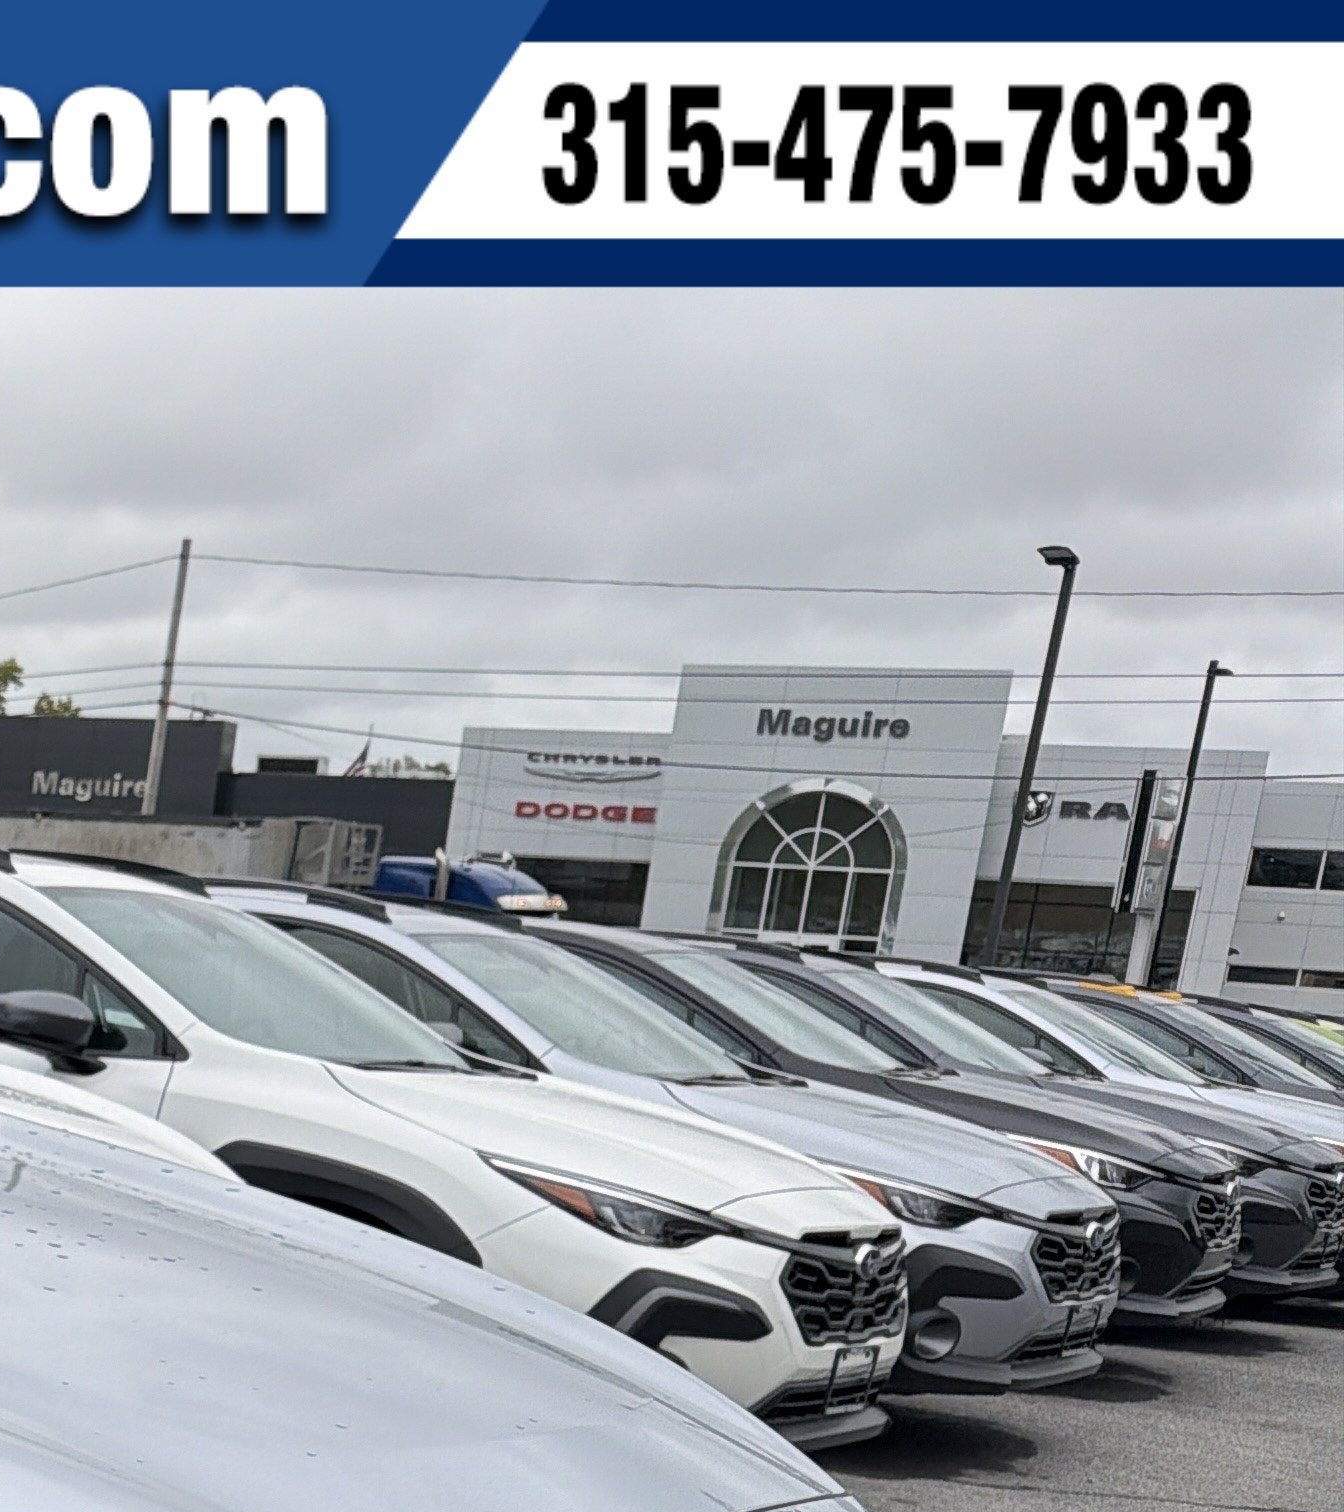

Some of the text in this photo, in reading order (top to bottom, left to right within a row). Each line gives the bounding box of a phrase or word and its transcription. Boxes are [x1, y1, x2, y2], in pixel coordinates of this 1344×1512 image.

[755, 707, 911, 743] Maguire
[526, 751, 662, 766] CHRYSLER
[514, 800, 657, 824] DODGE
[1059, 800, 1131, 821] RA
